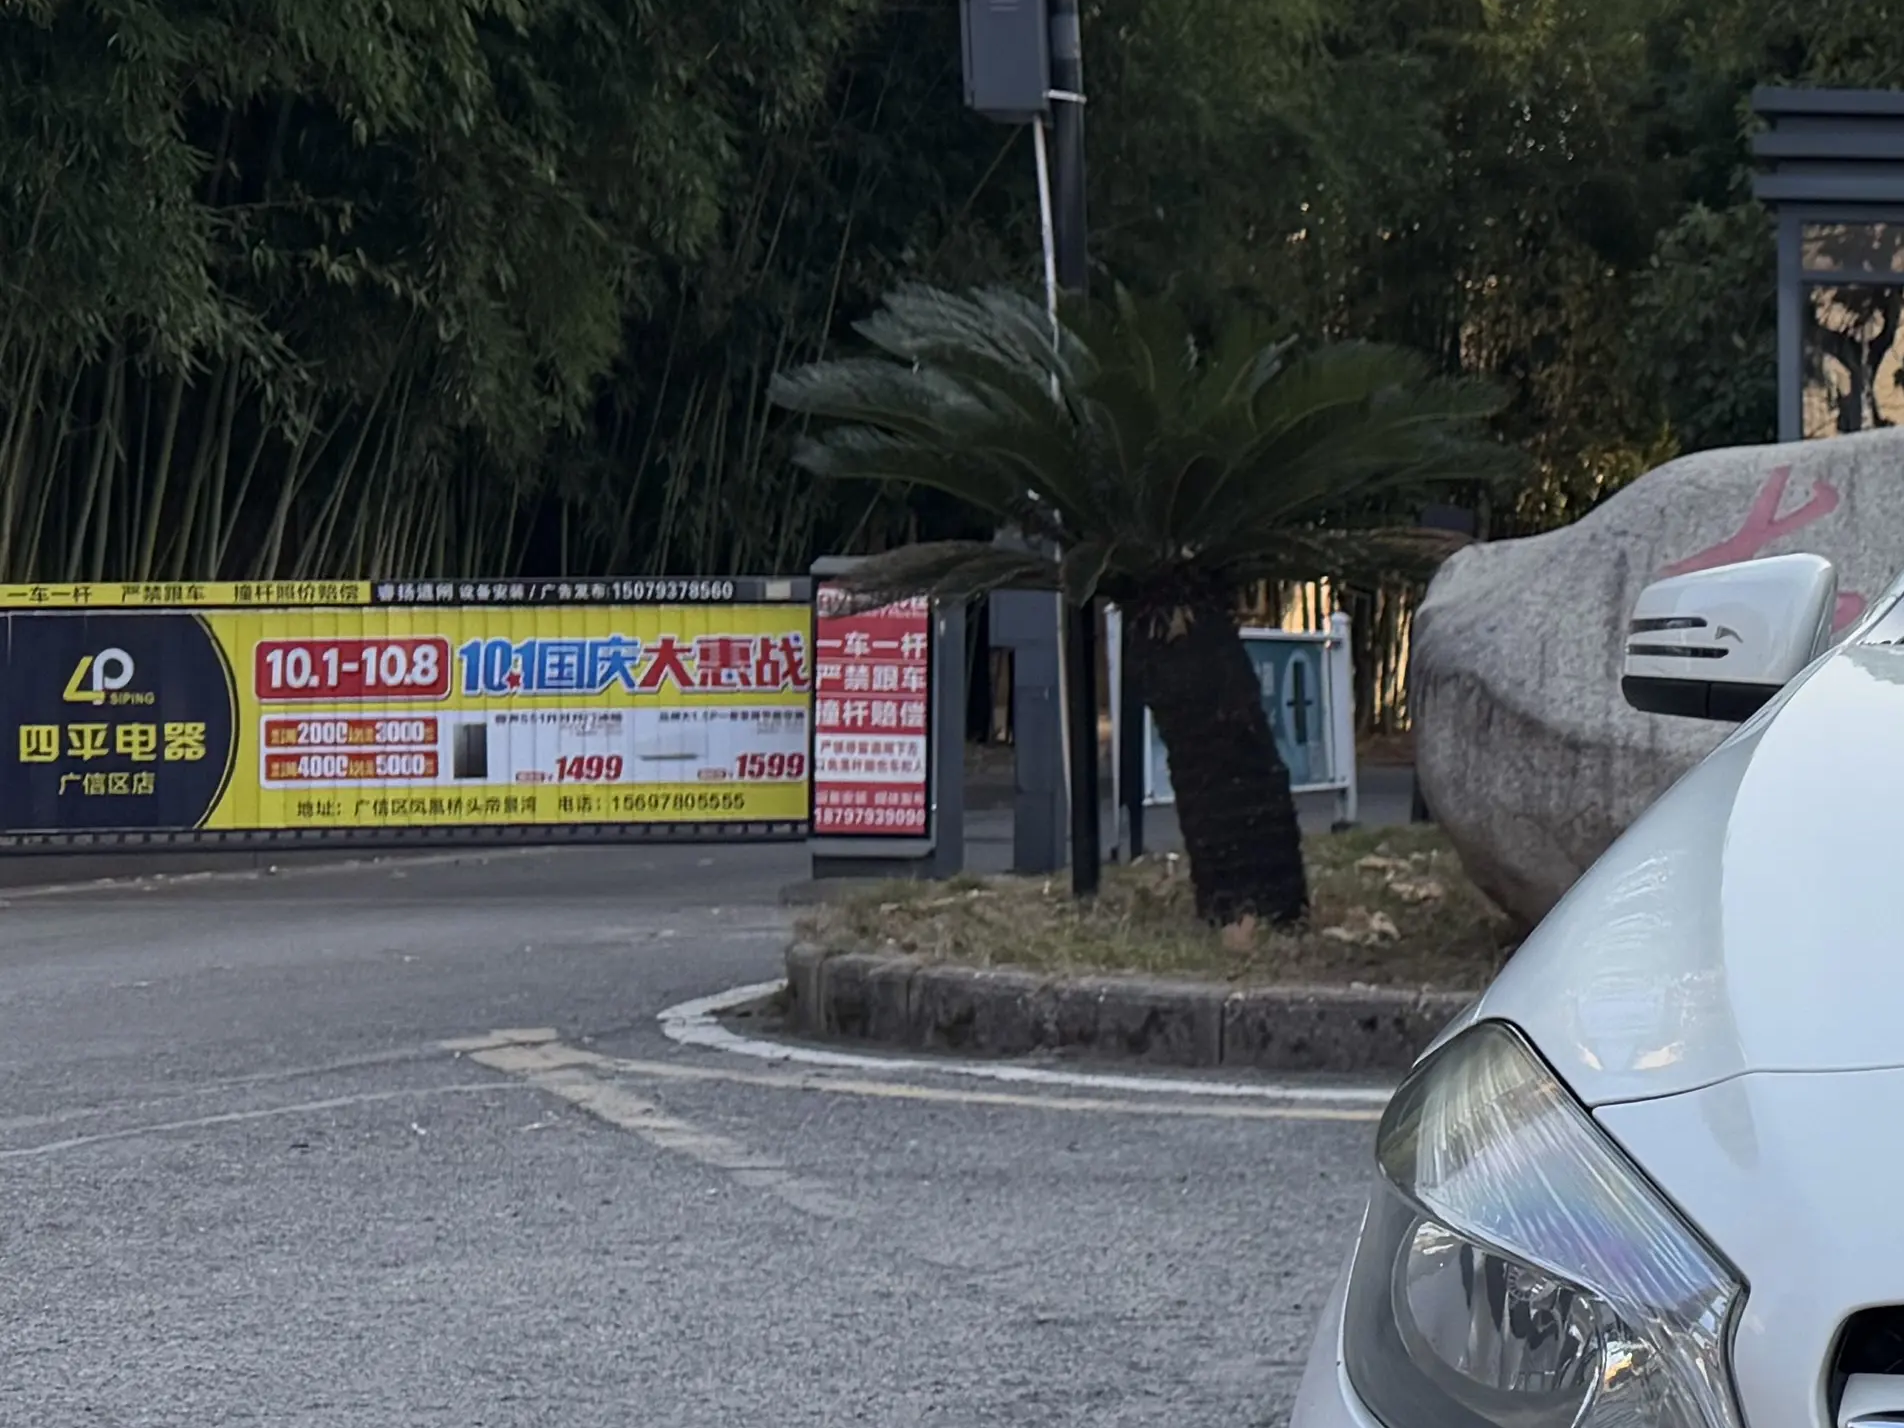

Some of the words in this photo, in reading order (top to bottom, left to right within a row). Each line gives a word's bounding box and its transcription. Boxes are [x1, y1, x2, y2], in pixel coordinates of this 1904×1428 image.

[7, 585, 93, 604] 一车一杆
[121, 584, 206, 603] 严禁跟车
[233, 582, 360, 604] 撞杆照价赔偿
[816, 630, 927, 660] 一车一杆
[265, 644, 439, 690] 10.1-10.8
[815, 663, 927, 693] 严禁跟车
[110, 691, 155, 705] SIPING
[815, 698, 927, 729] 撞杆赔偿
[19, 723, 206, 762] 四平电器
[59, 771, 156, 796] 广信区店
